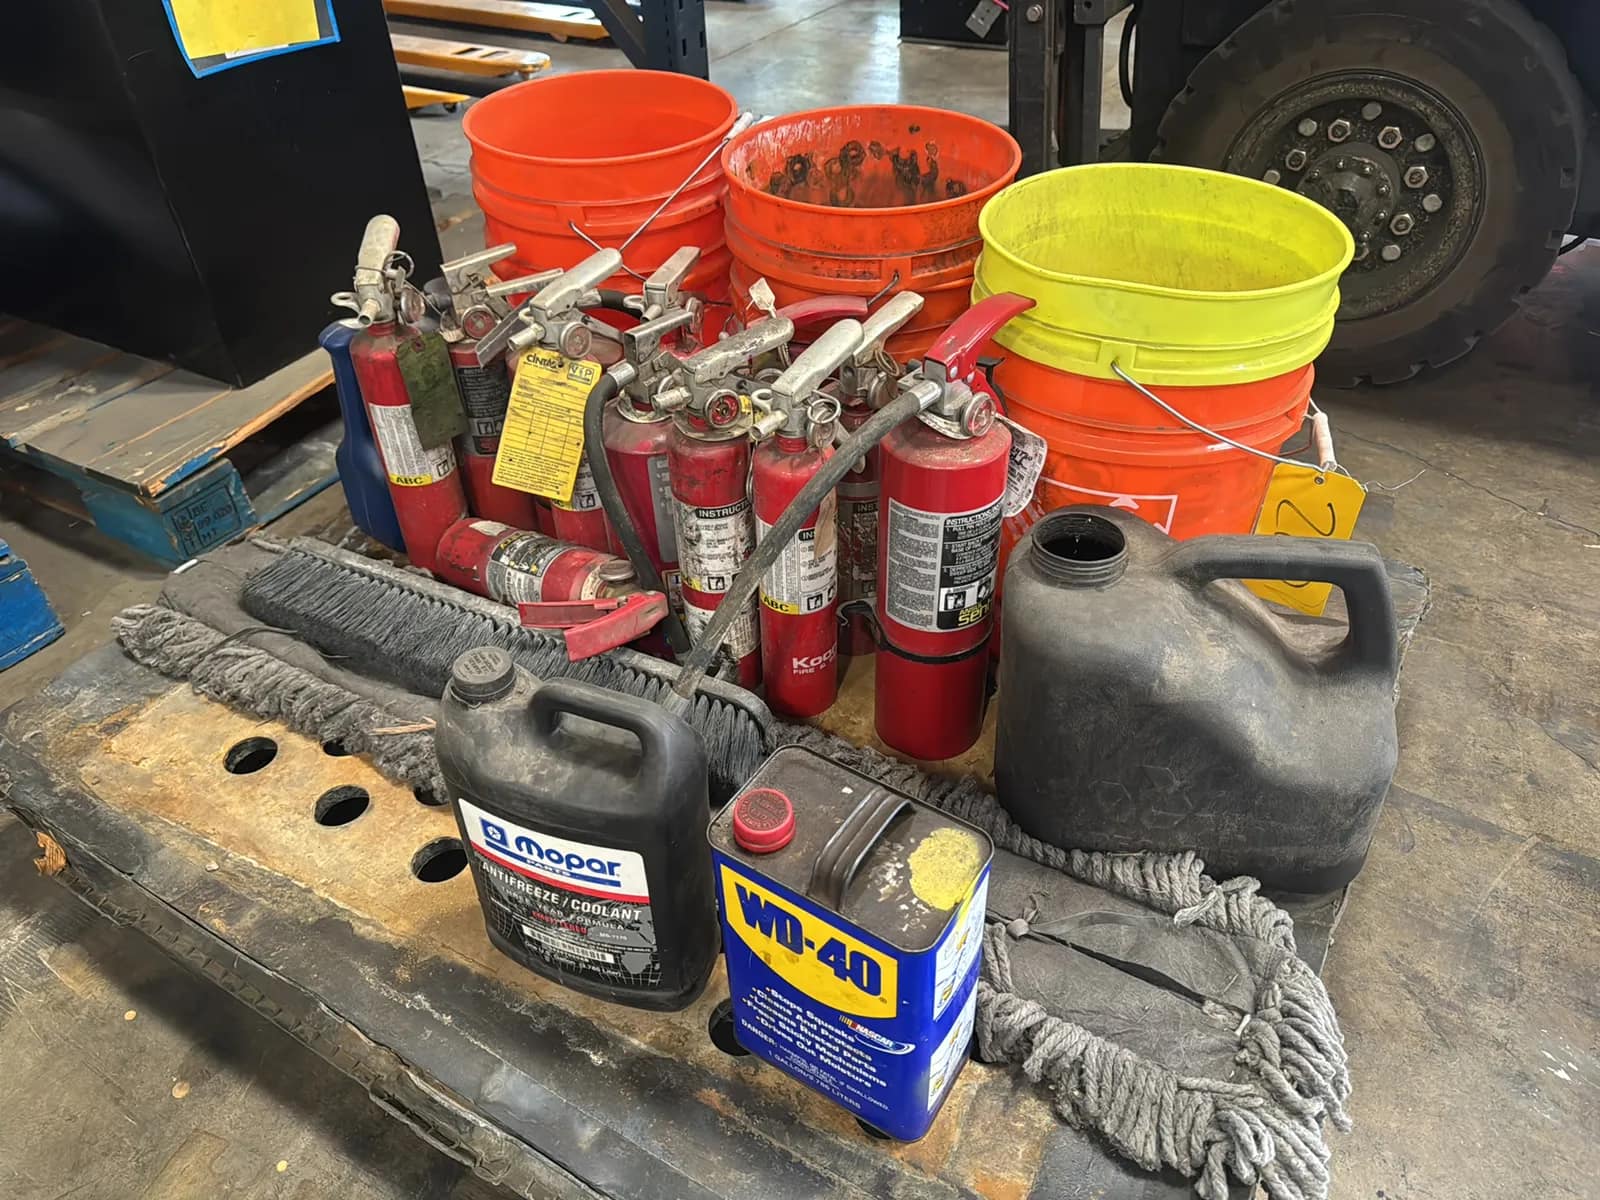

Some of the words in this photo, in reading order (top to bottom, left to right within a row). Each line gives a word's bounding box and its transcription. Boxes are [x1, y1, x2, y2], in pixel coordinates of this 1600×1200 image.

[396, 476, 423, 485] ABC
[764, 595, 790, 612] ABC
[482, 862, 559, 905] ANTIFREEZE
[571, 899, 642, 921] COOLANT
[735, 882, 882, 996] WD-40
[755, 996, 797, 1027] Loosens
[800, 1024, 839, 1052] Rusted
[843, 1050, 876, 1073] Parts
[757, 990, 793, 1016] Cleans
[796, 1014, 817, 1031] And
[821, 1028, 872, 1061] Protects
[771, 989, 803, 1013] Stops
[806, 1010, 855, 1043] Squeaks
[857, 1024, 895, 1049] NASCAR
[761, 1017, 793, 1042] Drives
[796, 1040, 816, 1056] Out
[820, 1054, 872, 1088] Moisture
[779, 1021, 812, 1046] Sticky
[815, 1043, 887, 1087] Mechanisms
